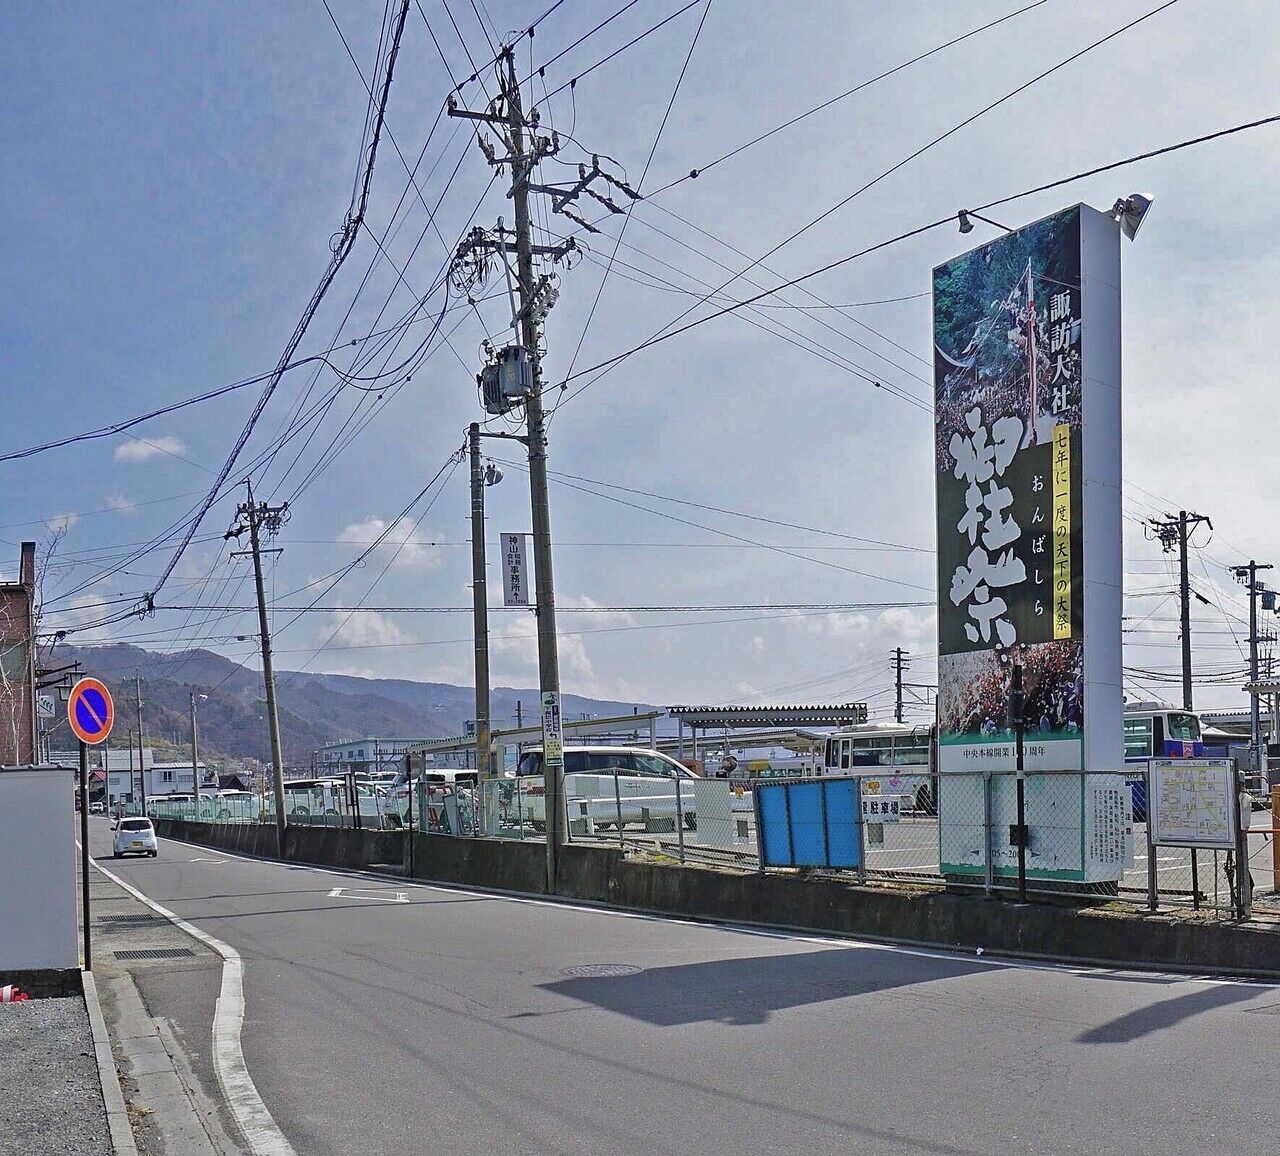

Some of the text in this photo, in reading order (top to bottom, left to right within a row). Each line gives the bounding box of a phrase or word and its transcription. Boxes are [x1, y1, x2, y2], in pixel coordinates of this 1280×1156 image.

[1050, 289, 1071, 414] 諏訪大社
[510, 566, 520, 592] 事務所
[949, 406, 1027, 648] 御柱祭
[1030, 474, 1046, 618] おんばしら
[1054, 434, 1070, 632] 七年に一度の天下の大祭
[963, 746, 1046, 758] 中央本線開業10周年
[1125, 813, 1132, 835] 注意
